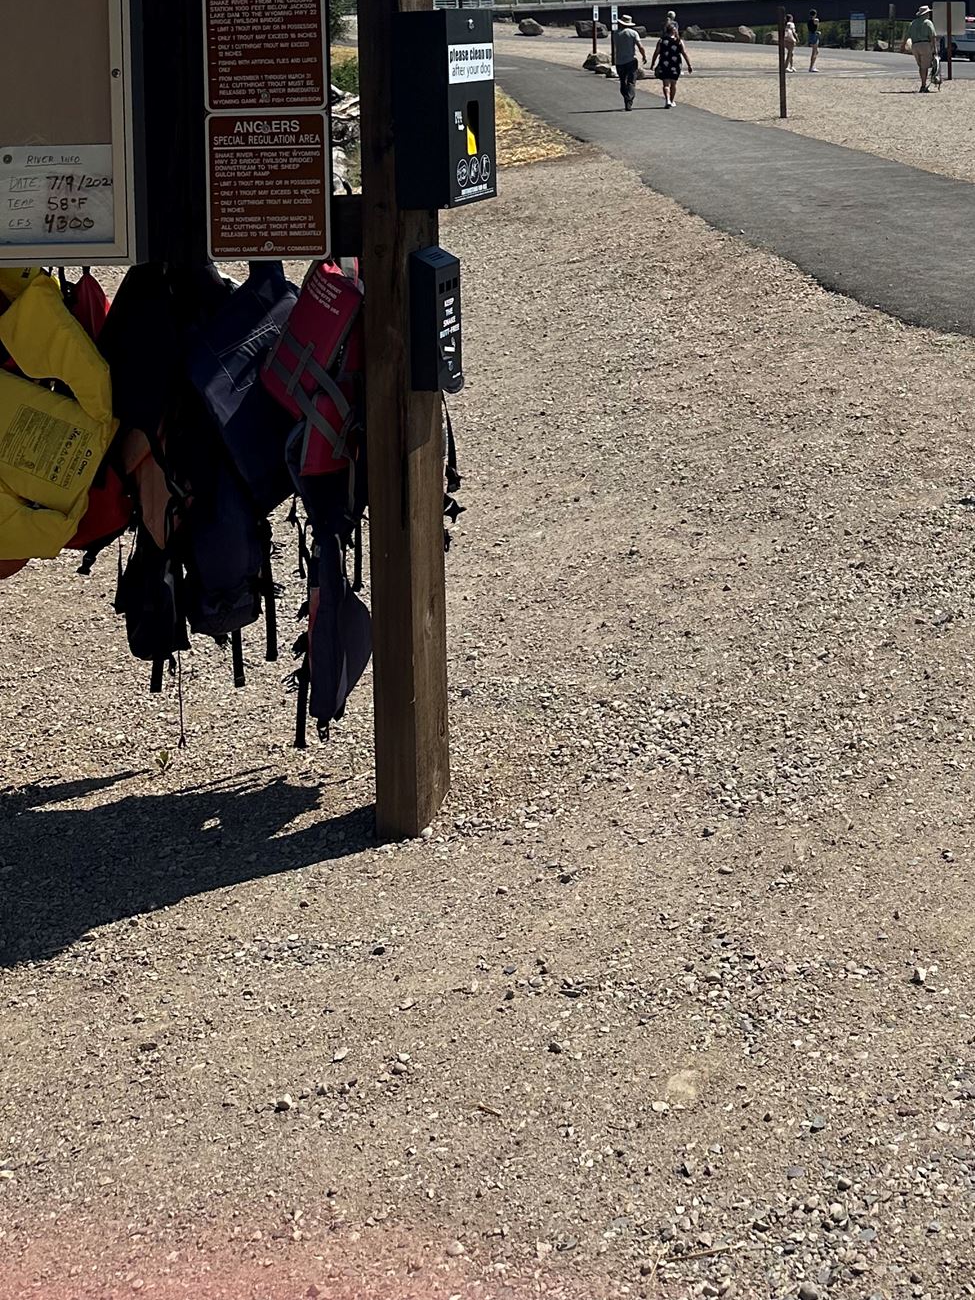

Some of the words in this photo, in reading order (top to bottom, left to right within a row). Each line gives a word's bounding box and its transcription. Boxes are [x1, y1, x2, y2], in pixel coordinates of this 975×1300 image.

[450, 48, 468, 63] please
[470, 47, 484, 60] clean
[486, 49, 491, 60] up
[452, 64, 465, 76] after
[467, 65, 479, 78] your
[480, 62, 490, 76] dog
[213, 136, 245, 145] SPECIAL
[248, 134, 295, 144] REGULATION
[298, 134, 320, 143] AREA
[27, 155, 53, 164] RIVER
[61, 155, 81, 163] INFO
[9, 219, 32, 227] CFS
[45, 214, 94, 233] 4300
